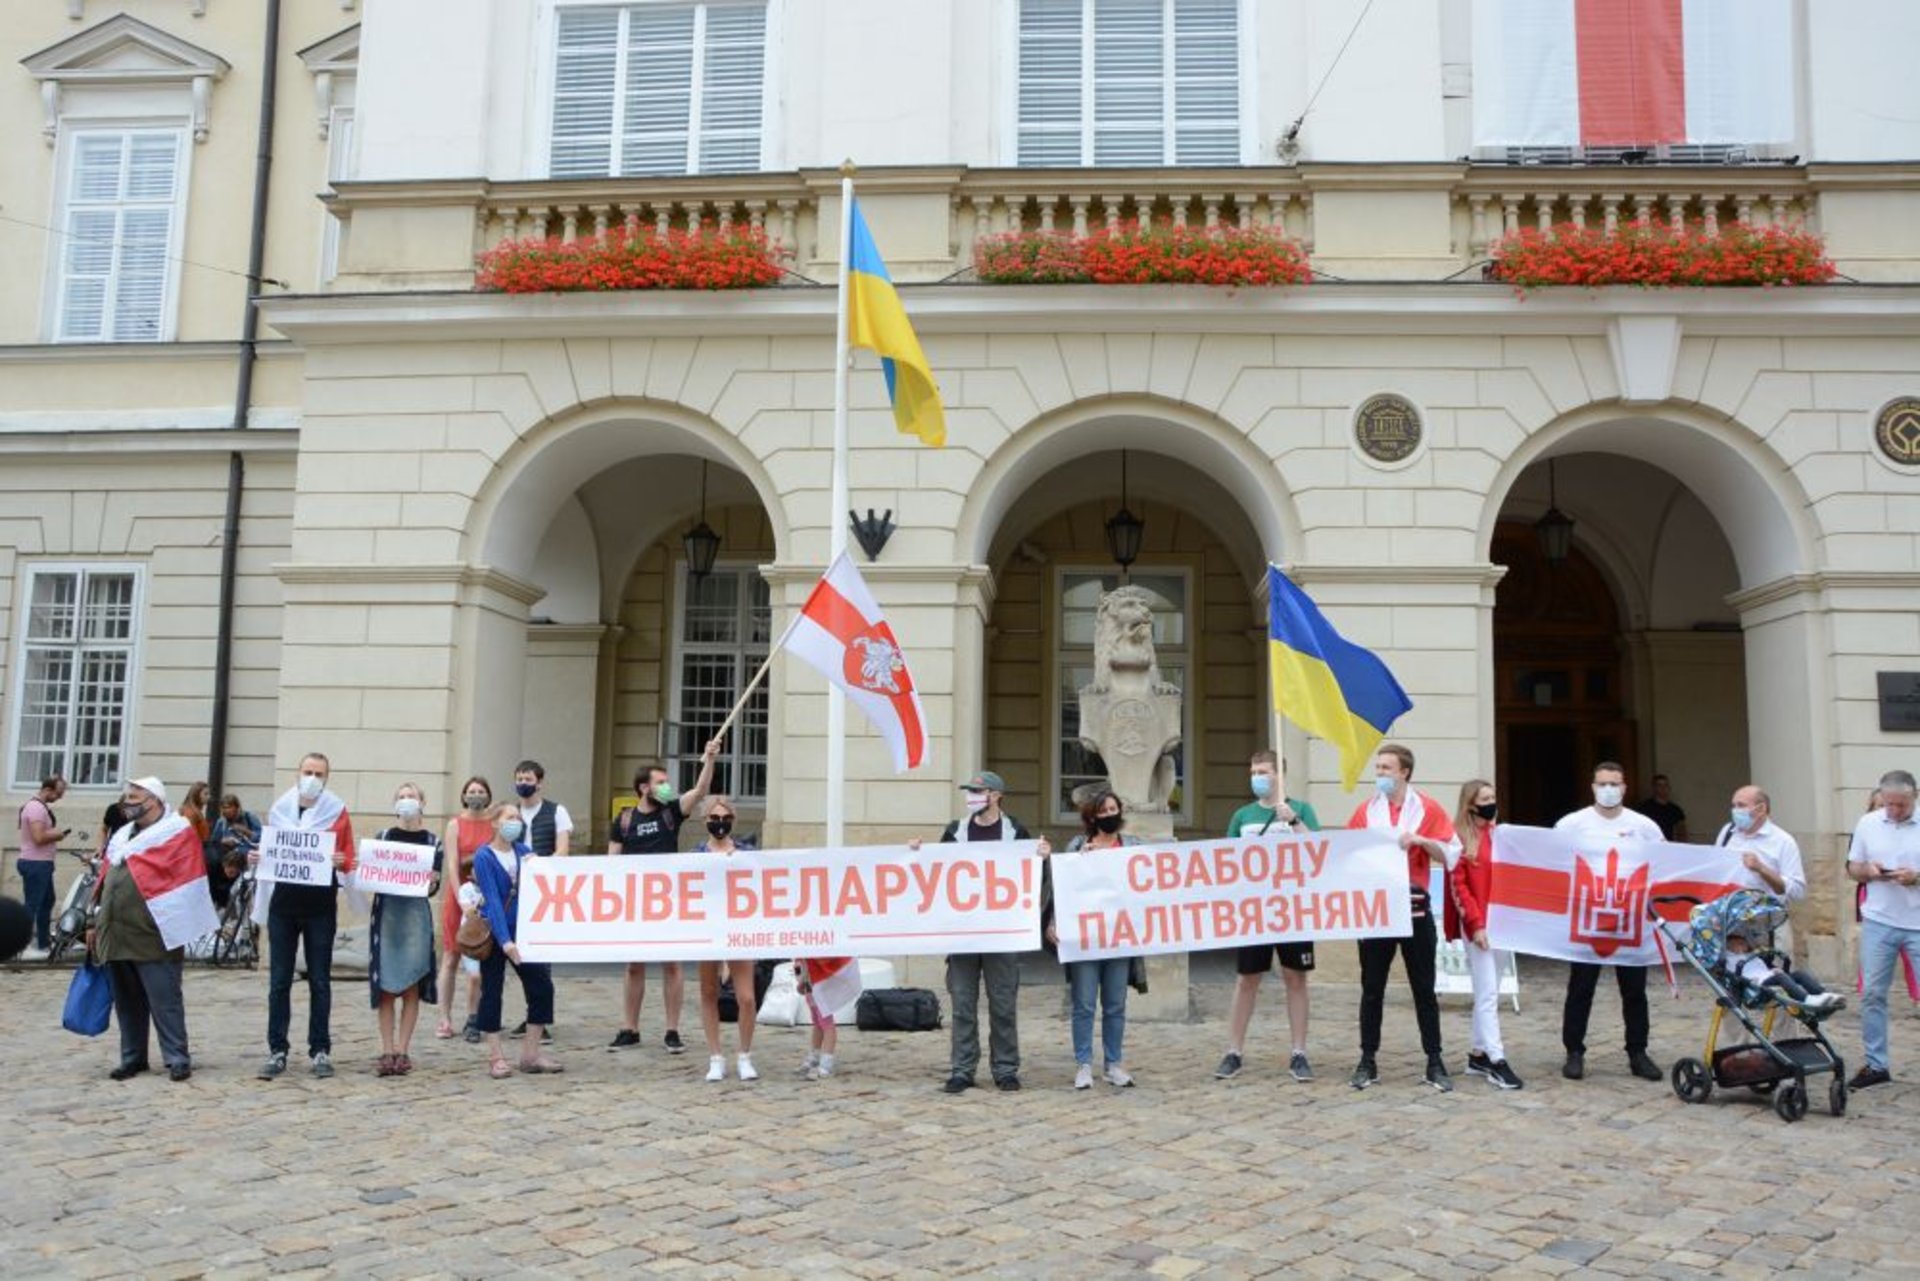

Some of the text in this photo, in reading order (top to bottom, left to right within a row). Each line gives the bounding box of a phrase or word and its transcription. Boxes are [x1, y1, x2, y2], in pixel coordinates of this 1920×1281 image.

[266, 848, 278, 859] НЕ
[276, 831, 320, 848] НІШТО
[1127, 840, 1331, 893] СВАБОДУ
[530, 859, 1034, 923] ЖЫВЕ БЕЛАРУСЬ!
[1078, 889, 1389, 951] ПАЛІТВЯЗНЯМ
[727, 930, 834, 948] ЖЫВЕ ВЕЧНА!
